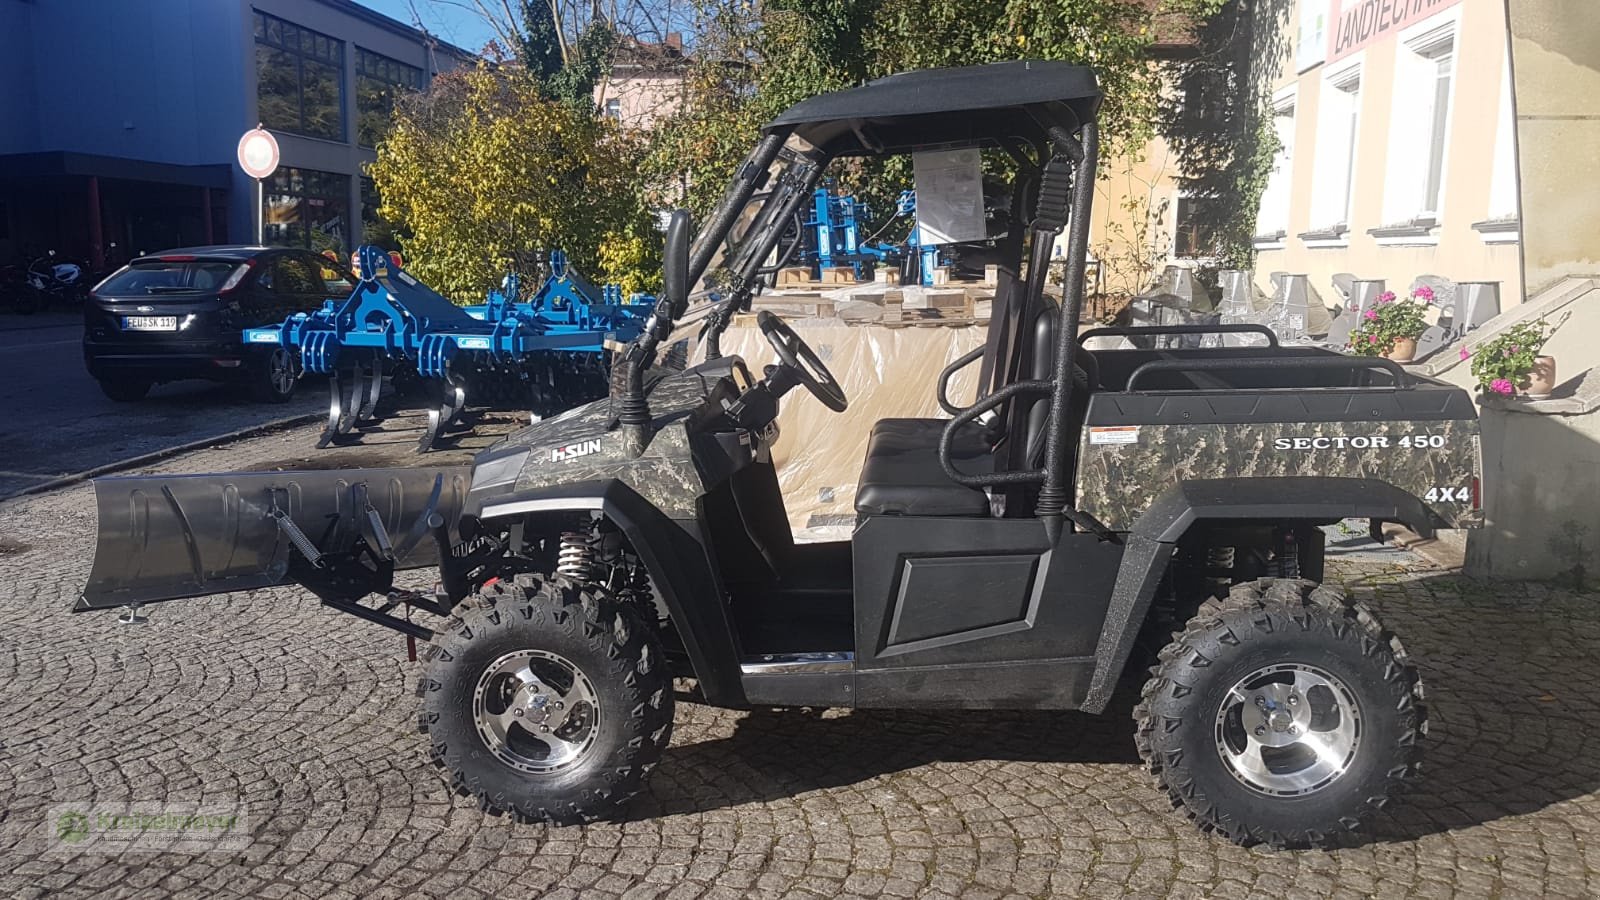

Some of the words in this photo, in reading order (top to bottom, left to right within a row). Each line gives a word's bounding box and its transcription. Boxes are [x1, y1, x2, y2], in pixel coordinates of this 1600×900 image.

[1334, 0, 1443, 54] LANDTECH
[551, 438, 601, 463] HSUN
[1274, 436, 1390, 450] SECTOR
[1398, 435, 1445, 449] 450
[1424, 486, 1470, 502] 4X4
